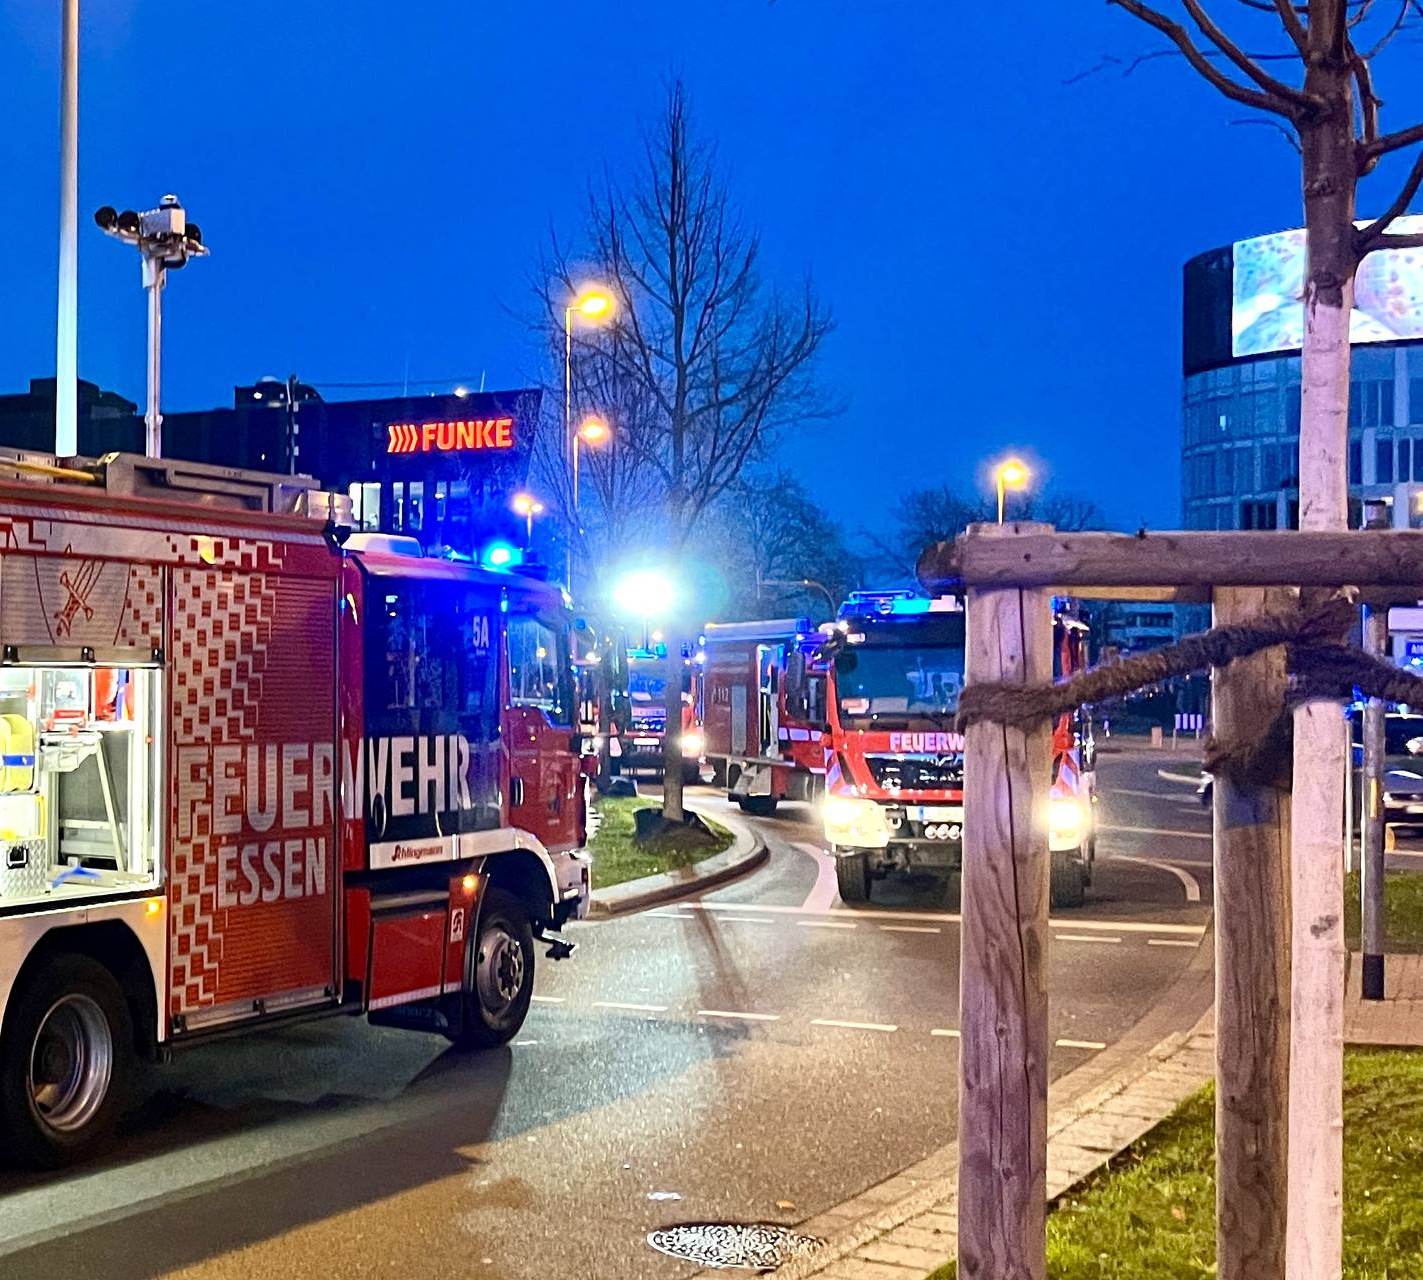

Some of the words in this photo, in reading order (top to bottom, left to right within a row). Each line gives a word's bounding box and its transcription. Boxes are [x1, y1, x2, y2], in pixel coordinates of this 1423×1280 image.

[422, 418, 513, 451] FUNKE
[473, 615, 489, 648] 5A
[890, 732, 965, 752] FEUERW
[178, 734, 472, 837] FEUERWEHR
[217, 837, 327, 909] ESSEN
